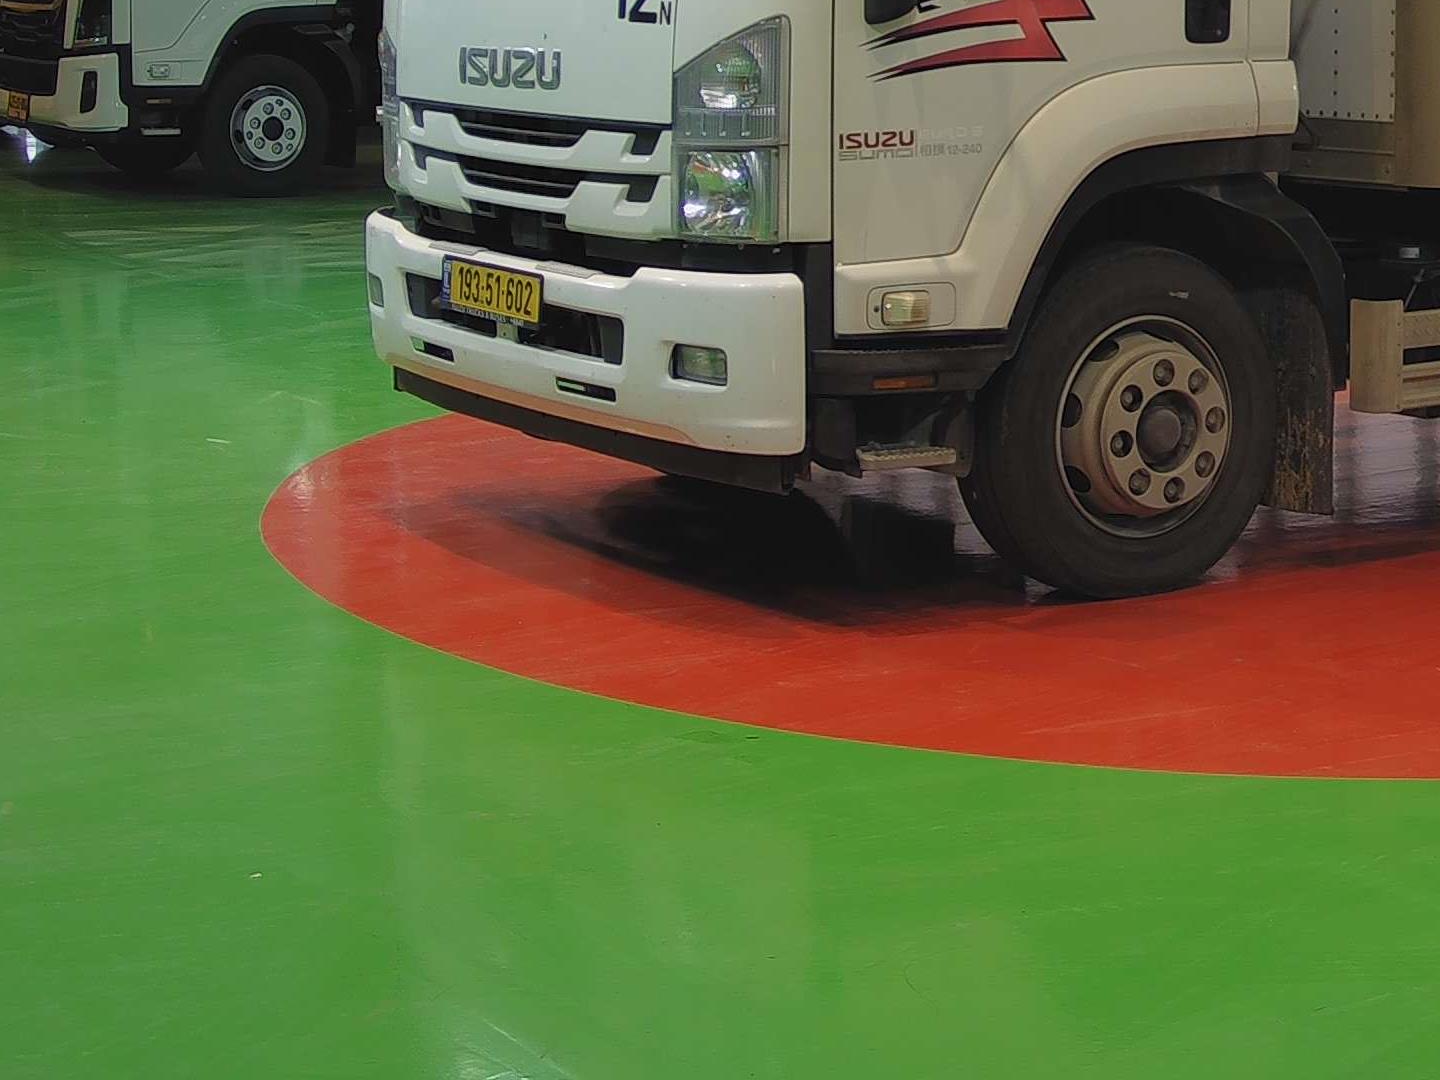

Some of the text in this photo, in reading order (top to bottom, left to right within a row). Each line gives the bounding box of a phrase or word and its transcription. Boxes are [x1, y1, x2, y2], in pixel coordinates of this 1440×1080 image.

[459, 47, 561, 90] ISUZU
[839, 129, 914, 149] ISUZU
[838, 149, 913, 161] SUMO
